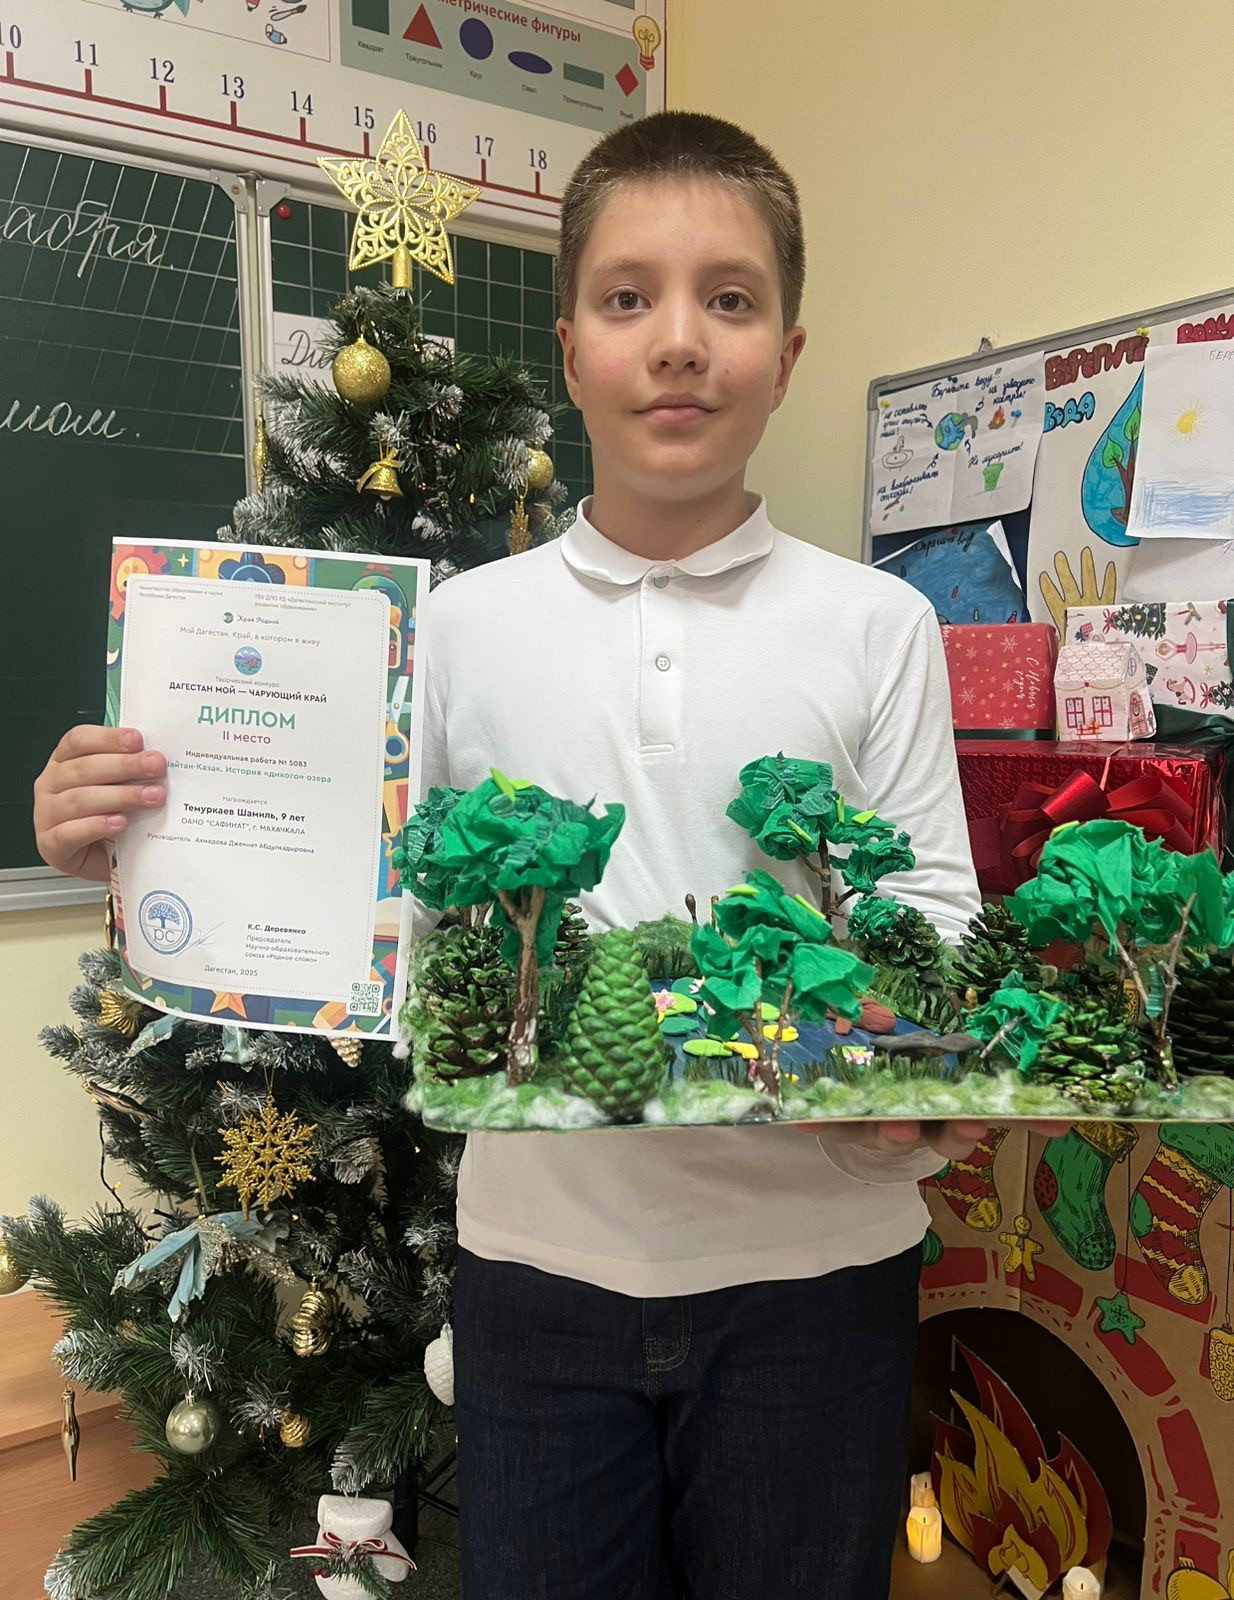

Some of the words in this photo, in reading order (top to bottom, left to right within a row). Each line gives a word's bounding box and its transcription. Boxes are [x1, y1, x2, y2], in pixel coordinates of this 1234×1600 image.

[437, 0, 527, 27] етрические
[531, 17, 581, 43] фигуры
[74, 40, 99, 67] 11
[357, 40, 384, 53] Квадрат
[405, 52, 443, 68] Треугольник
[150, 57, 175, 83] 12
[470, 70, 483, 80] Круг
[221, 74, 245, 99] 13
[290, 91, 314, 115] 14
[353, 106, 375, 129] 15
[417, 121, 437, 145] 16
[474, 135, 494, 157] 17
[529, 149, 547, 170] 18
[1043, 391, 1095, 433] ВОДА
[180, 626, 194, 634] Мой
[232, 631, 253, 642] Край,
[261, 635, 293, 645] котором
[301, 638, 320, 647] живу
[169, 681, 213, 693] ДАГЕСТАН
[215, 684, 236, 695] МОЙ
[249, 688, 302, 701] ЧАРУЮЩИЙ
[304, 693, 327, 703] КРАЙ
[215, 676, 253, 686] Творческий
[254, 680, 280, 689] конкурс
[197, 705, 296, 730] ДИПЛОМ
[222, 731, 229, 741] II
[234, 734, 271, 744] место
[185, 750, 248, 763] Индивидуальная
[250, 755, 277, 765] работа
[289, 759, 308, 768] 5083
[225, 766, 262, 777] История
[264, 769, 304, 781] «дикого»
[306, 774, 332, 784] озера
[222, 795, 268, 806] Награждается
[183, 803, 235, 817] Темуркаев
[237, 808, 279, 821] Шамиль,
[281, 812, 287, 821] 9
[288, 814, 306, 823] лет
[181, 817, 204, 826] ОАНО
[260, 825, 306, 836] МАХАЧКАЛА
[147, 832, 191, 843] Руководитель
[195, 837, 228, 847] Ахмедова
[247, 923, 263, 932] К.С.
[264, 925, 307, 935] Деревянко
[246, 934, 292, 945] Председатель
[245, 943, 330, 957] Научно-образовательного
[245, 951, 265, 960] союза
[204, 965, 239, 976] Дагестан,
[240, 968, 259, 977] 2025
